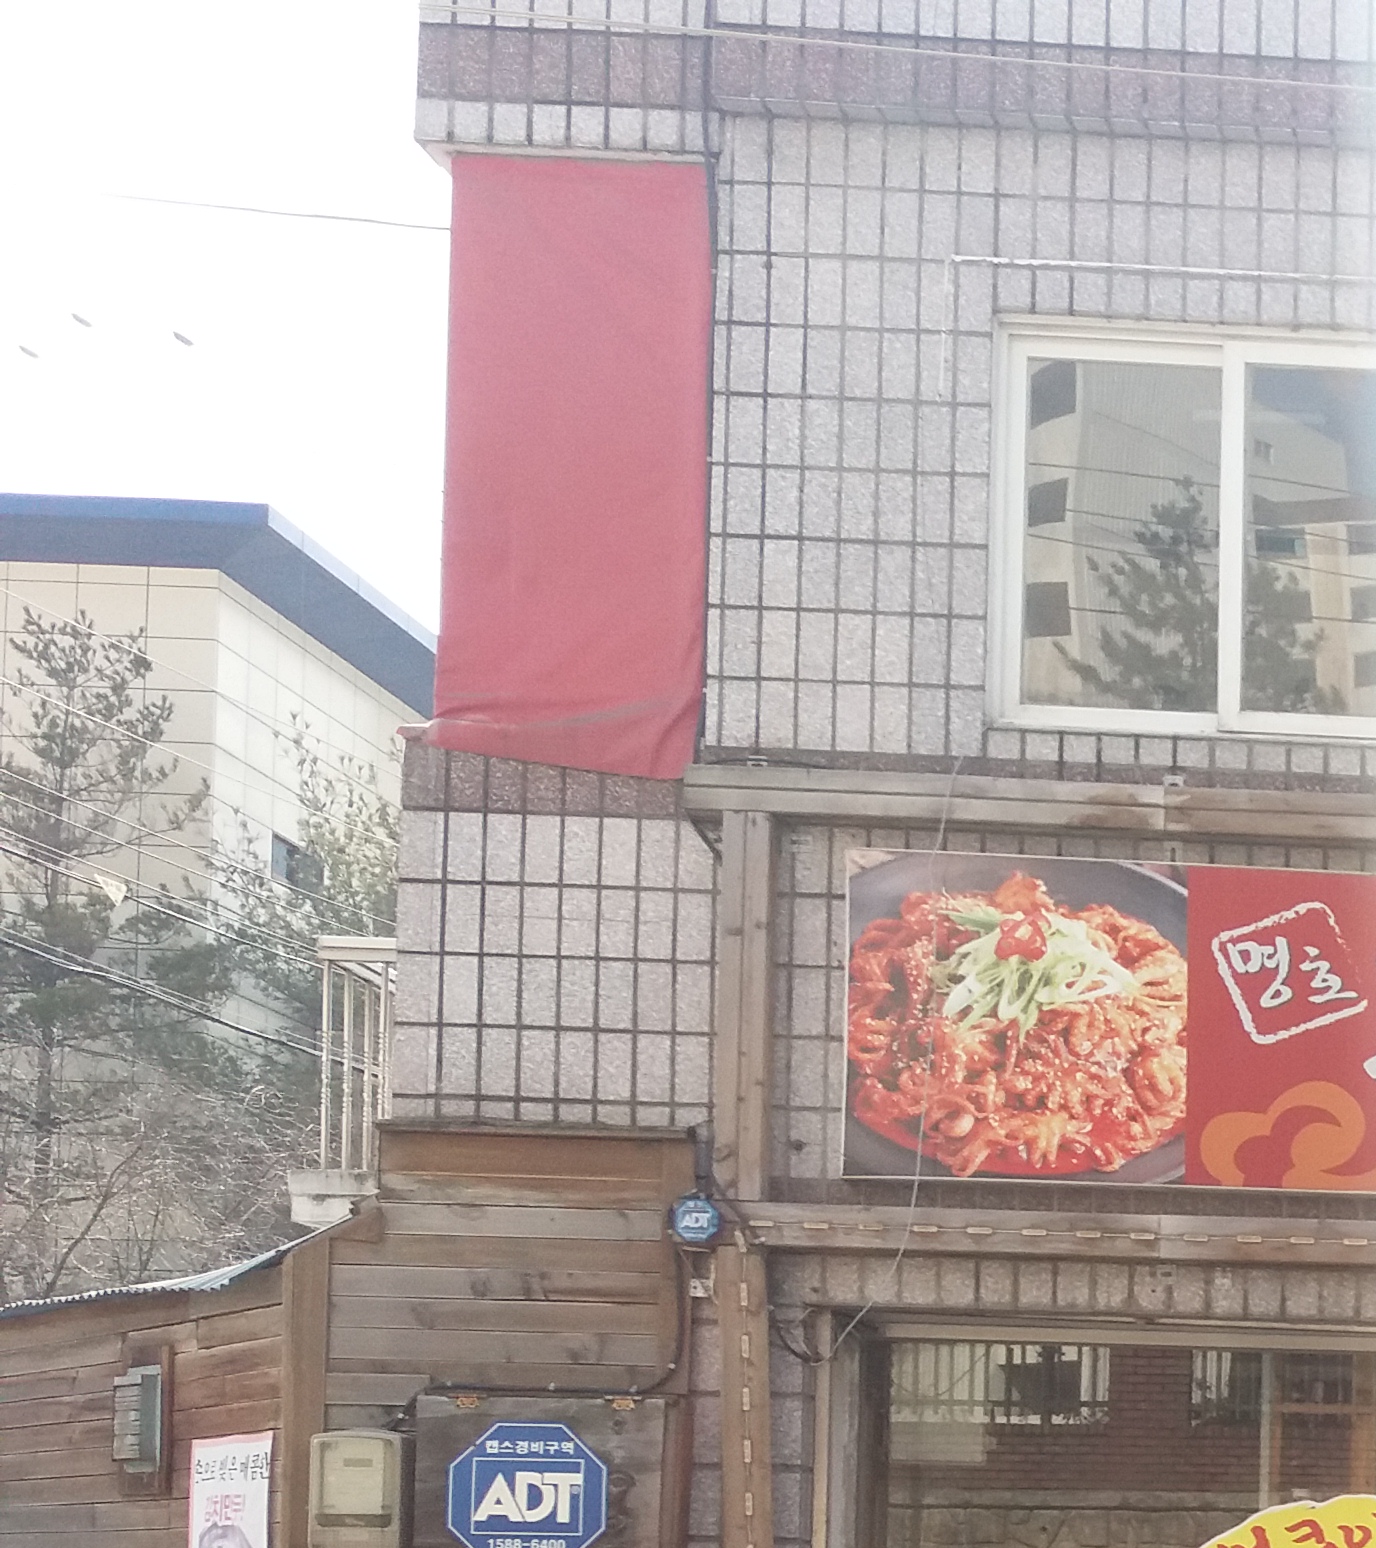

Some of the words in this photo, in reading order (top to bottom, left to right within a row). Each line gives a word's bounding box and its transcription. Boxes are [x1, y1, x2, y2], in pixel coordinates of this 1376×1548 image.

[680, 1212, 711, 1228] ADT
[485, 1440, 575, 1455] 캡스경비구역
[473, 1471, 582, 1524] ADT
